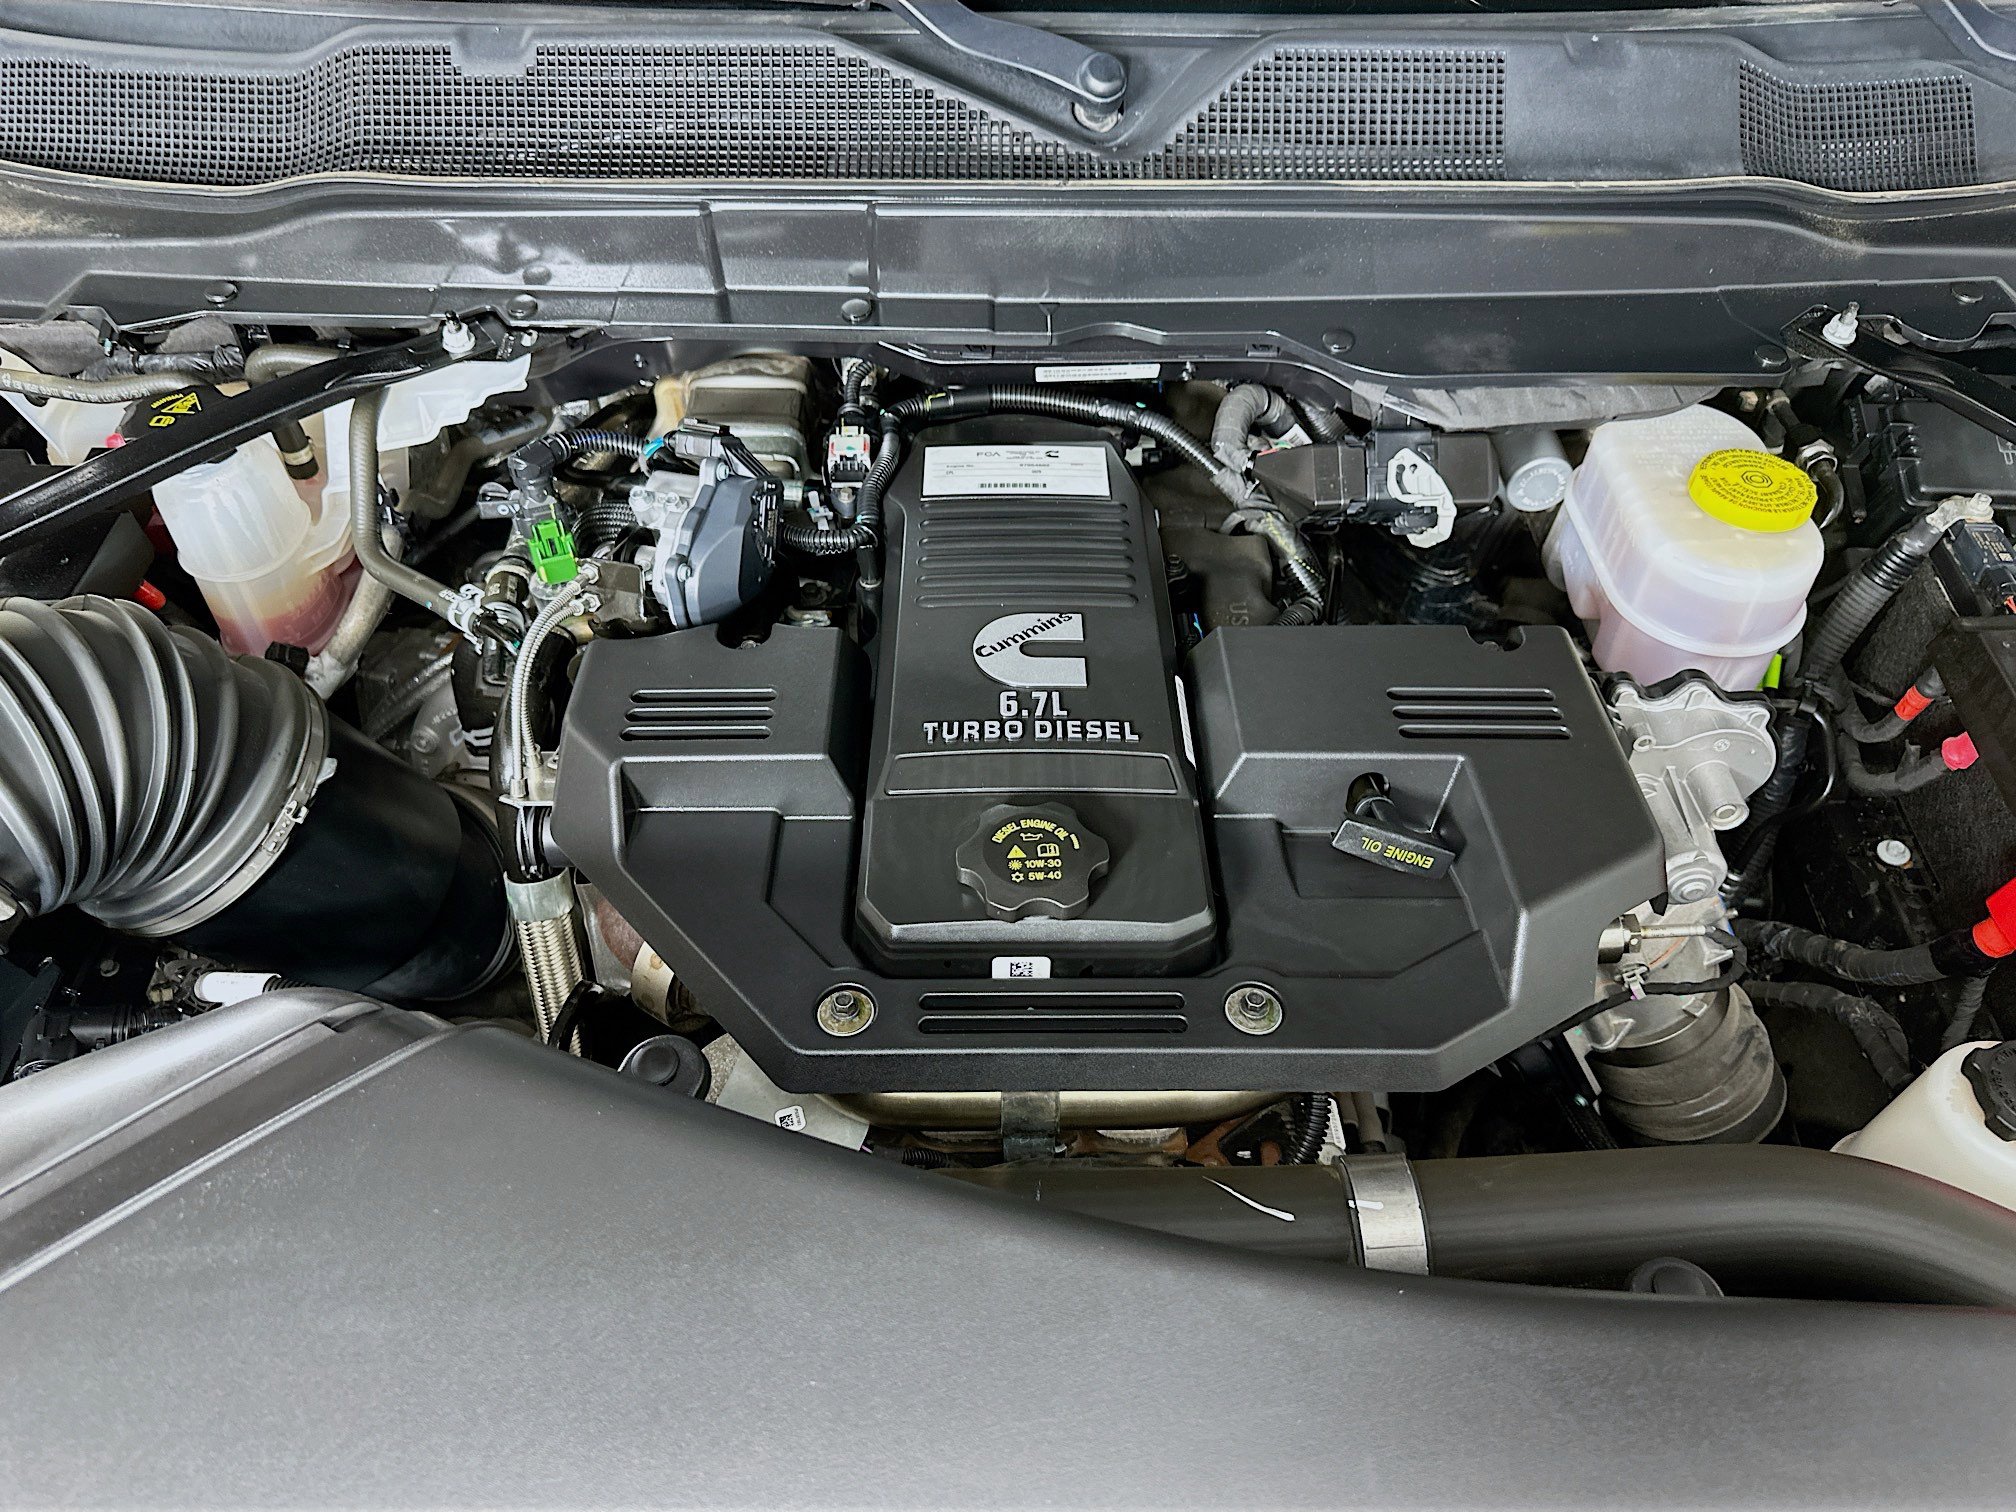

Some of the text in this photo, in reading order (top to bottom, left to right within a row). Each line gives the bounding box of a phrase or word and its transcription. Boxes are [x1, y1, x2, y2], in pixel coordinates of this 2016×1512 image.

[975, 612, 1073, 658] Cummins
[999, 690, 1068, 718] 6.7L
[923, 719, 1140, 744] TURBO DIESEL
[991, 818, 1069, 844] DIESEL ENGINE OIL
[1024, 858, 1062, 869] 10W-30
[1361, 836, 1435, 869] ENGINE OIL
[1028, 870, 1062, 881] 5W-40
